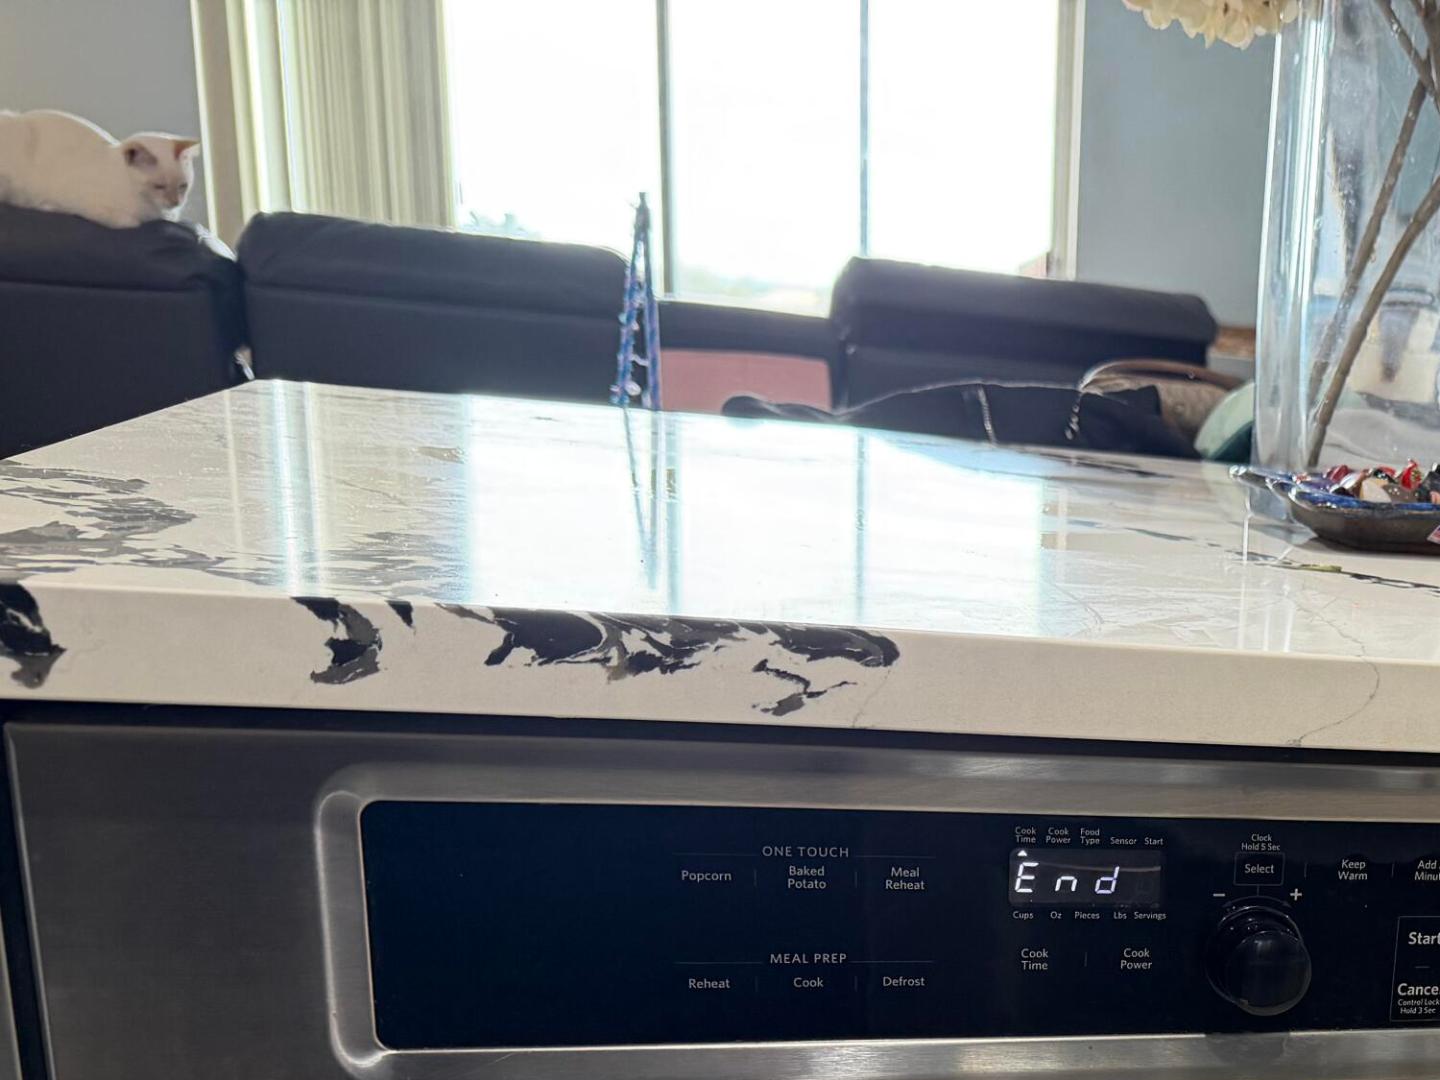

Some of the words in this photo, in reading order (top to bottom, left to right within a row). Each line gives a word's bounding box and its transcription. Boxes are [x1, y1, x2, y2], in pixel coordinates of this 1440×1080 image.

[1014, 826, 1036, 836] Cook
[1047, 827, 1069, 836] Cook
[1080, 828, 1100, 836] Food
[1015, 835, 1036, 844] Time
[1045, 836, 1071, 844] Power
[1080, 836, 1100, 846] Type
[1110, 837, 1137, 845] Sensor
[1144, 837, 1164, 846] Start
[1251, 833, 1272, 842] Clock
[762, 845, 792, 857] ONE
[797, 846, 849, 858] TOUCH
[1241, 843, 1260, 851] Hold
[1267, 843, 1281, 851] Sec
[1244, 863, 1275, 874] Select
[1341, 859, 1366, 871] Keep
[1417, 860, 1437, 870] Add
[681, 869, 732, 883] Popcorn
[788, 865, 825, 877] Baked
[890, 866, 920, 878] Meal
[1337, 871, 1368, 881] Warm
[1014, 861, 1120, 895] End
[787, 878, 827, 890] Potato
[885, 879, 925, 891] Reheat
[1013, 912, 1034, 921] Cups
[1050, 912, 1062, 920] Oz
[1074, 911, 1100, 920] Pieces
[1113, 912, 1127, 920] Lbs
[1134, 911, 1167, 921] Servings
[1021, 948, 1049, 959] Cook
[1123, 948, 1150, 958] Cook
[770, 953, 809, 964] MEAL
[814, 953, 847, 964] PREP
[1021, 961, 1048, 971] Time
[1120, 960, 1153, 970] Power
[688, 978, 731, 989] Reheat
[793, 976, 824, 988] Cook
[882, 976, 926, 988] Defrost
[1397, 998, 1424, 1007] Control
[1424, 998, 1440, 1007] Lock
[1400, 1006, 1417, 1015] Hold
[1423, 1007, 1436, 1015] Sec
